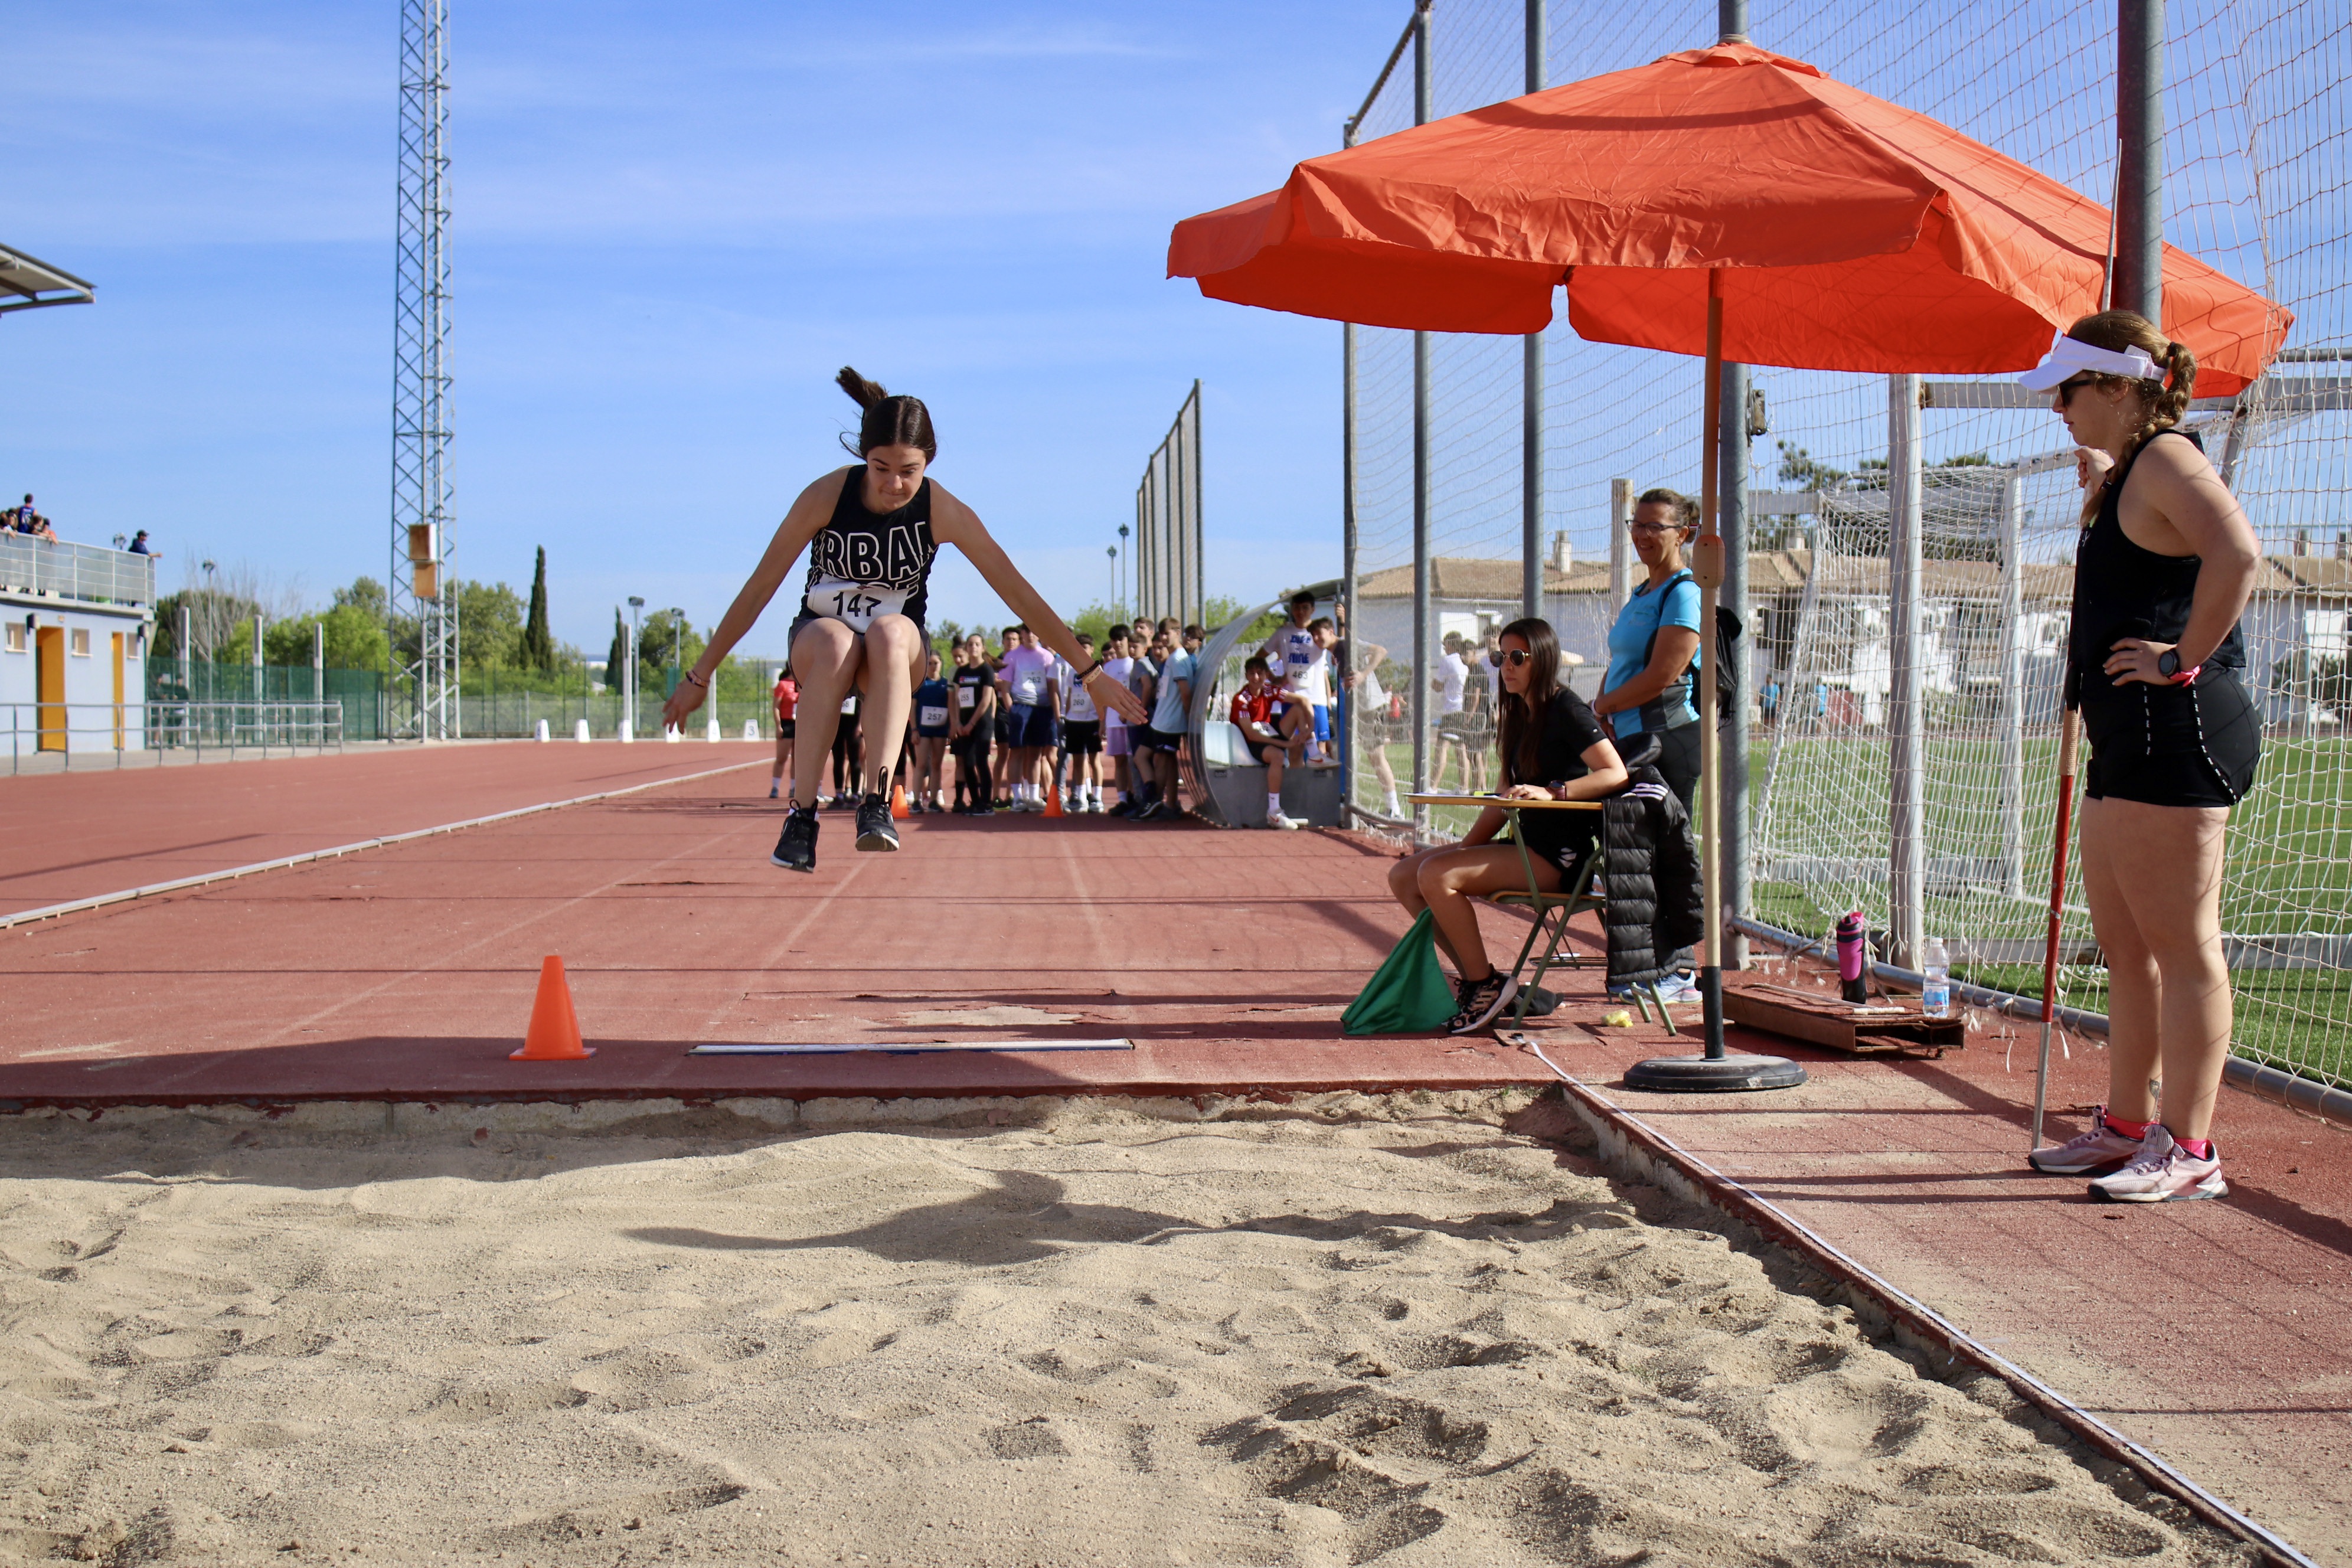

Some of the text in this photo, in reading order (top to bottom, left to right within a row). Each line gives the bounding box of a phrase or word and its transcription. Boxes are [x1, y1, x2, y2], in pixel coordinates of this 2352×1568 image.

[832, 591, 882, 618] 147
[1292, 670, 1308, 680] 463
[747, 726, 755, 736] 3
